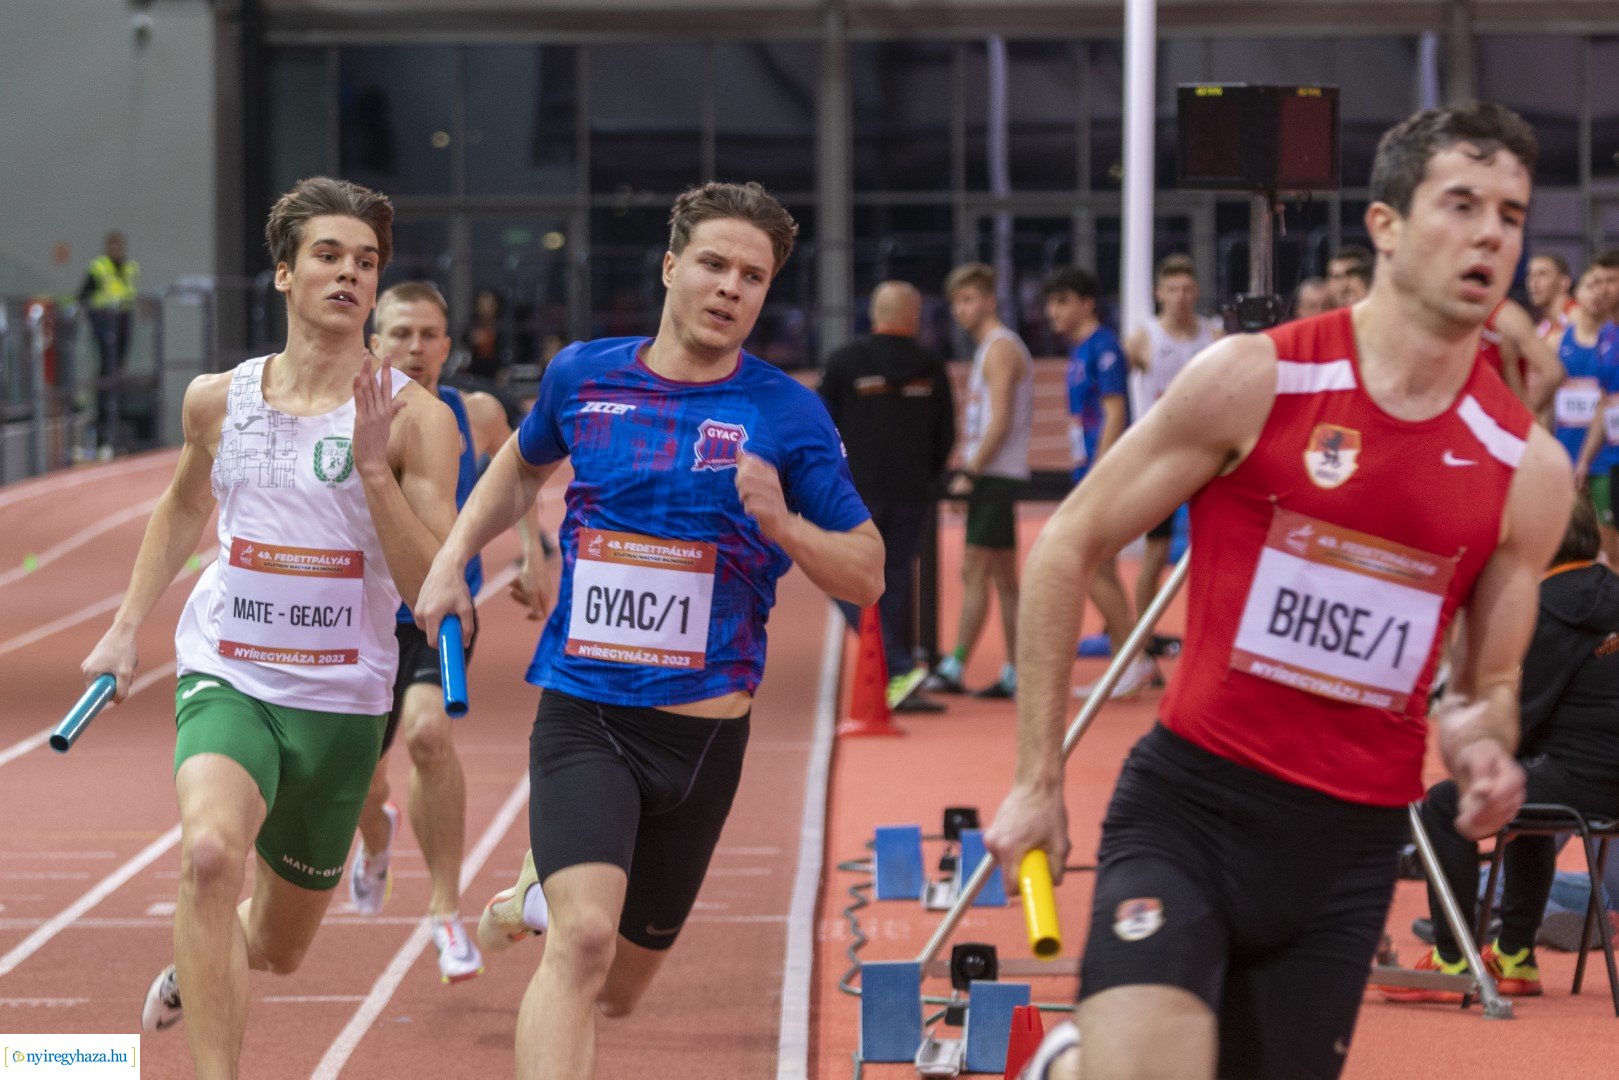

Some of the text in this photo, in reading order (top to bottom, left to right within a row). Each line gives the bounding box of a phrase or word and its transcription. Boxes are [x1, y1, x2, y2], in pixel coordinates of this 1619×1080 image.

[707, 427, 739, 442] GYAC
[257, 551, 351, 566] 49. FEDETTPÁLYÁS
[233, 596, 274, 625] MATE
[290, 605, 352, 627] GEAC/1
[585, 585, 690, 634] GYAC/1
[1267, 586, 1411, 669] BHSE/1
[234, 646, 346, 664] NYÍREGYHÁZA 2023
[578, 644, 659, 663] NYÍREGYHÁZA
